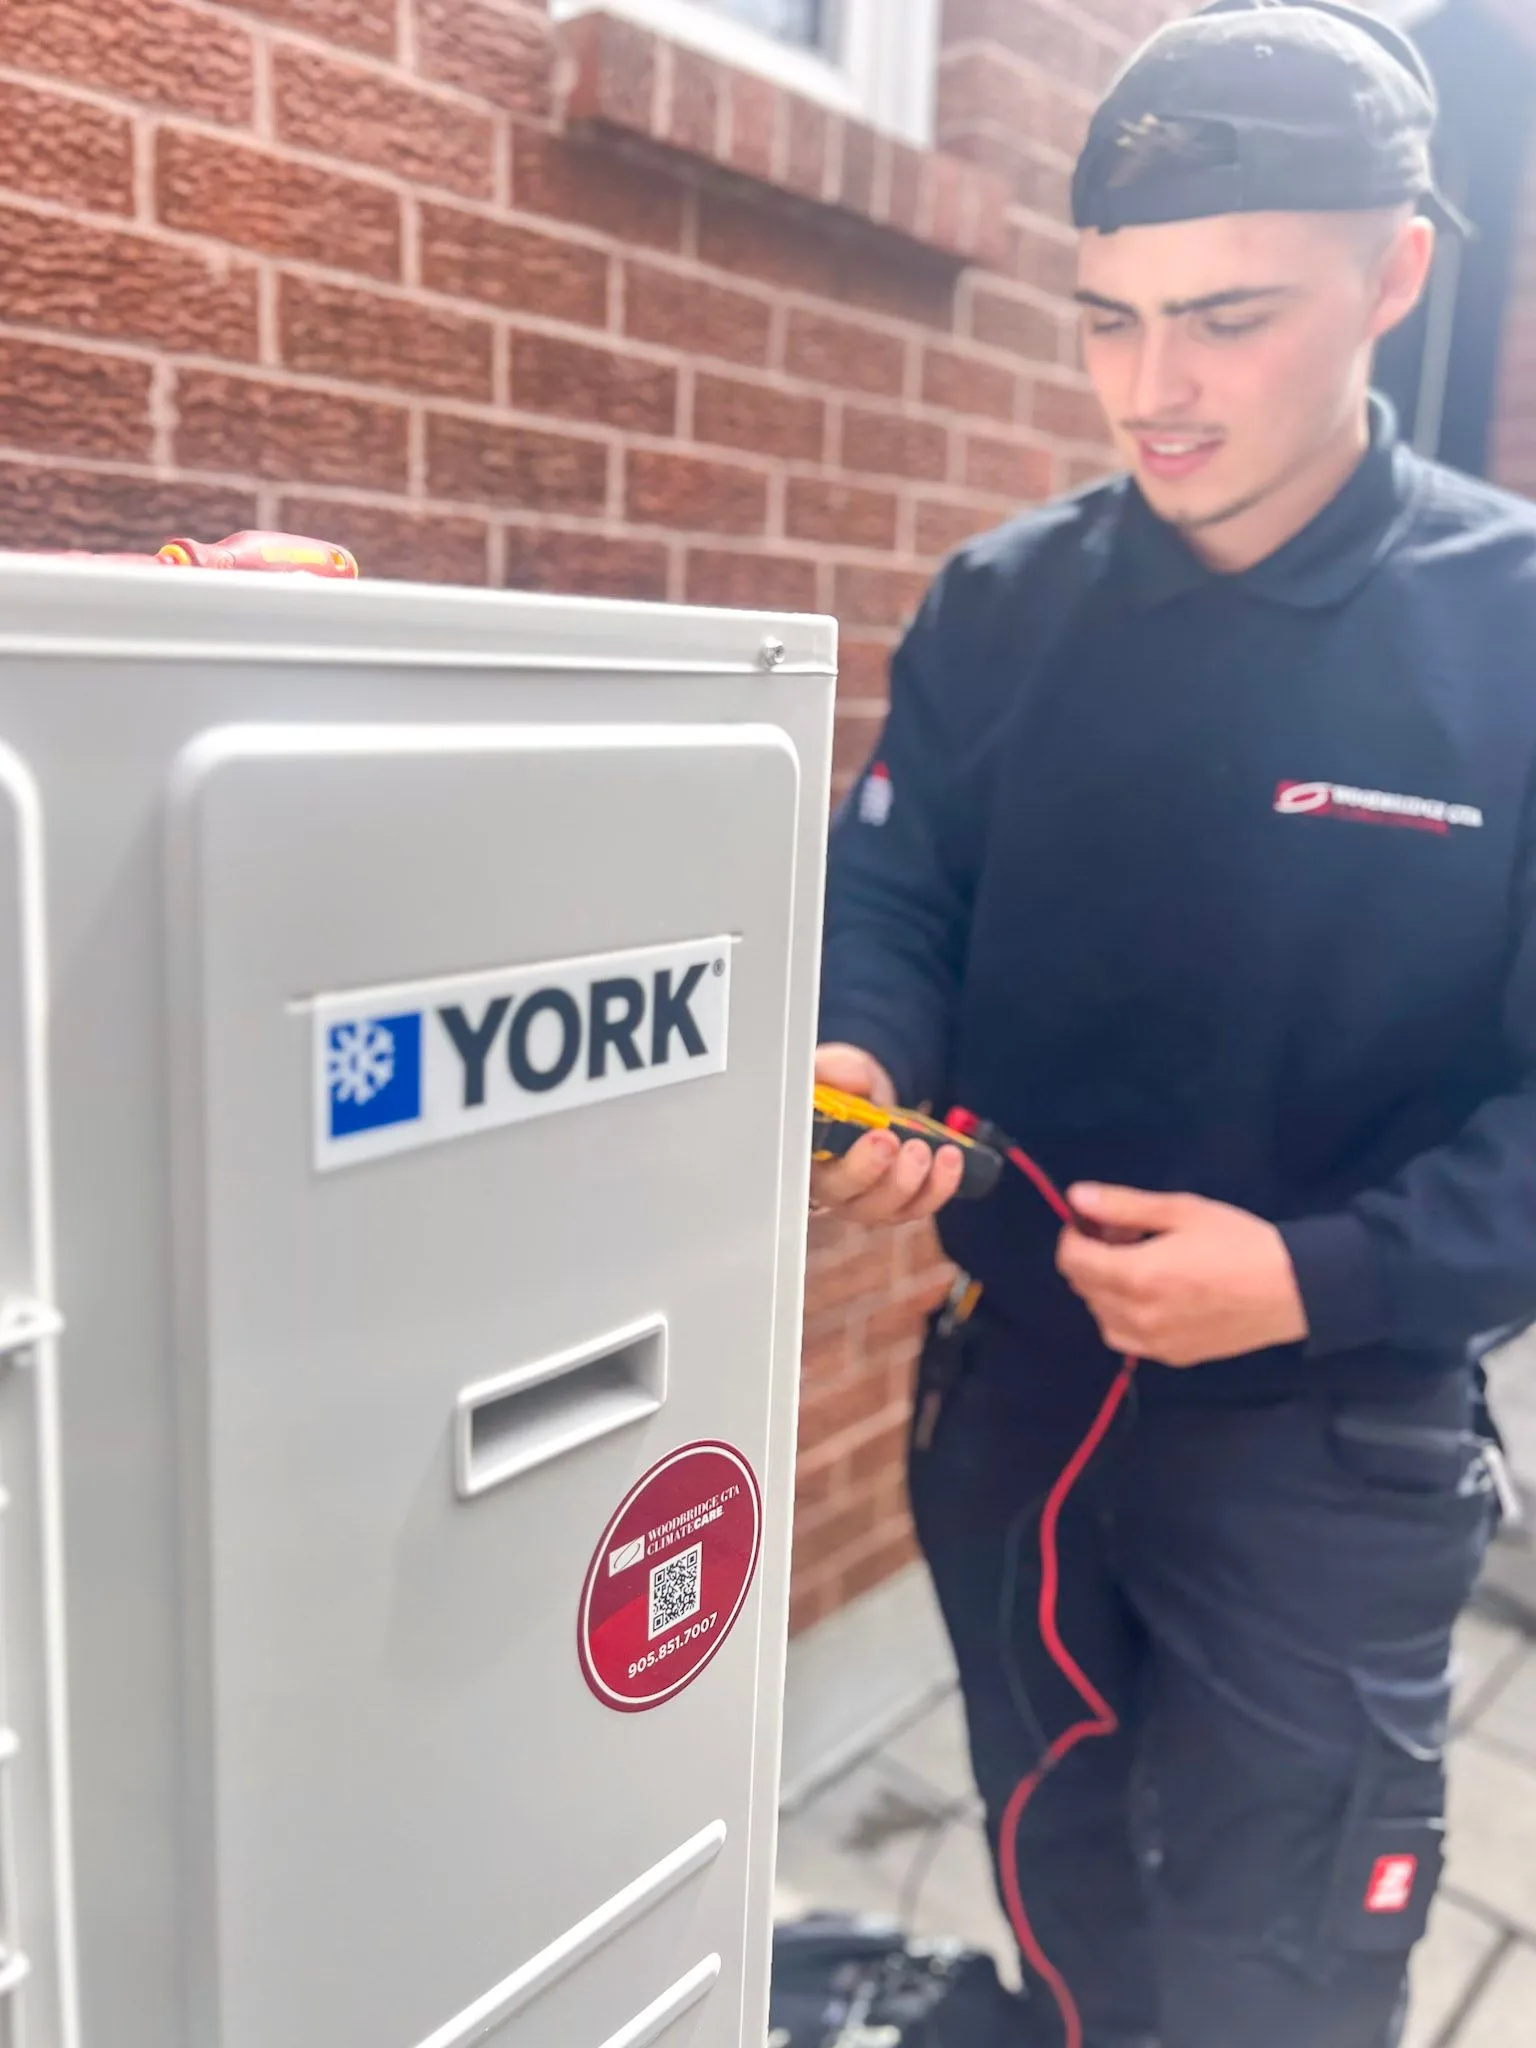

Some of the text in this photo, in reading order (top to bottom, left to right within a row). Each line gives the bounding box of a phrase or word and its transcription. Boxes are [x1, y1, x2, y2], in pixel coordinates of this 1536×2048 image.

[646, 1505, 724, 1555] CLIMATECARE
[648, 1484, 740, 1541] WOODBRIDGE GTA
[628, 1612, 718, 1678] 905.851.7007
